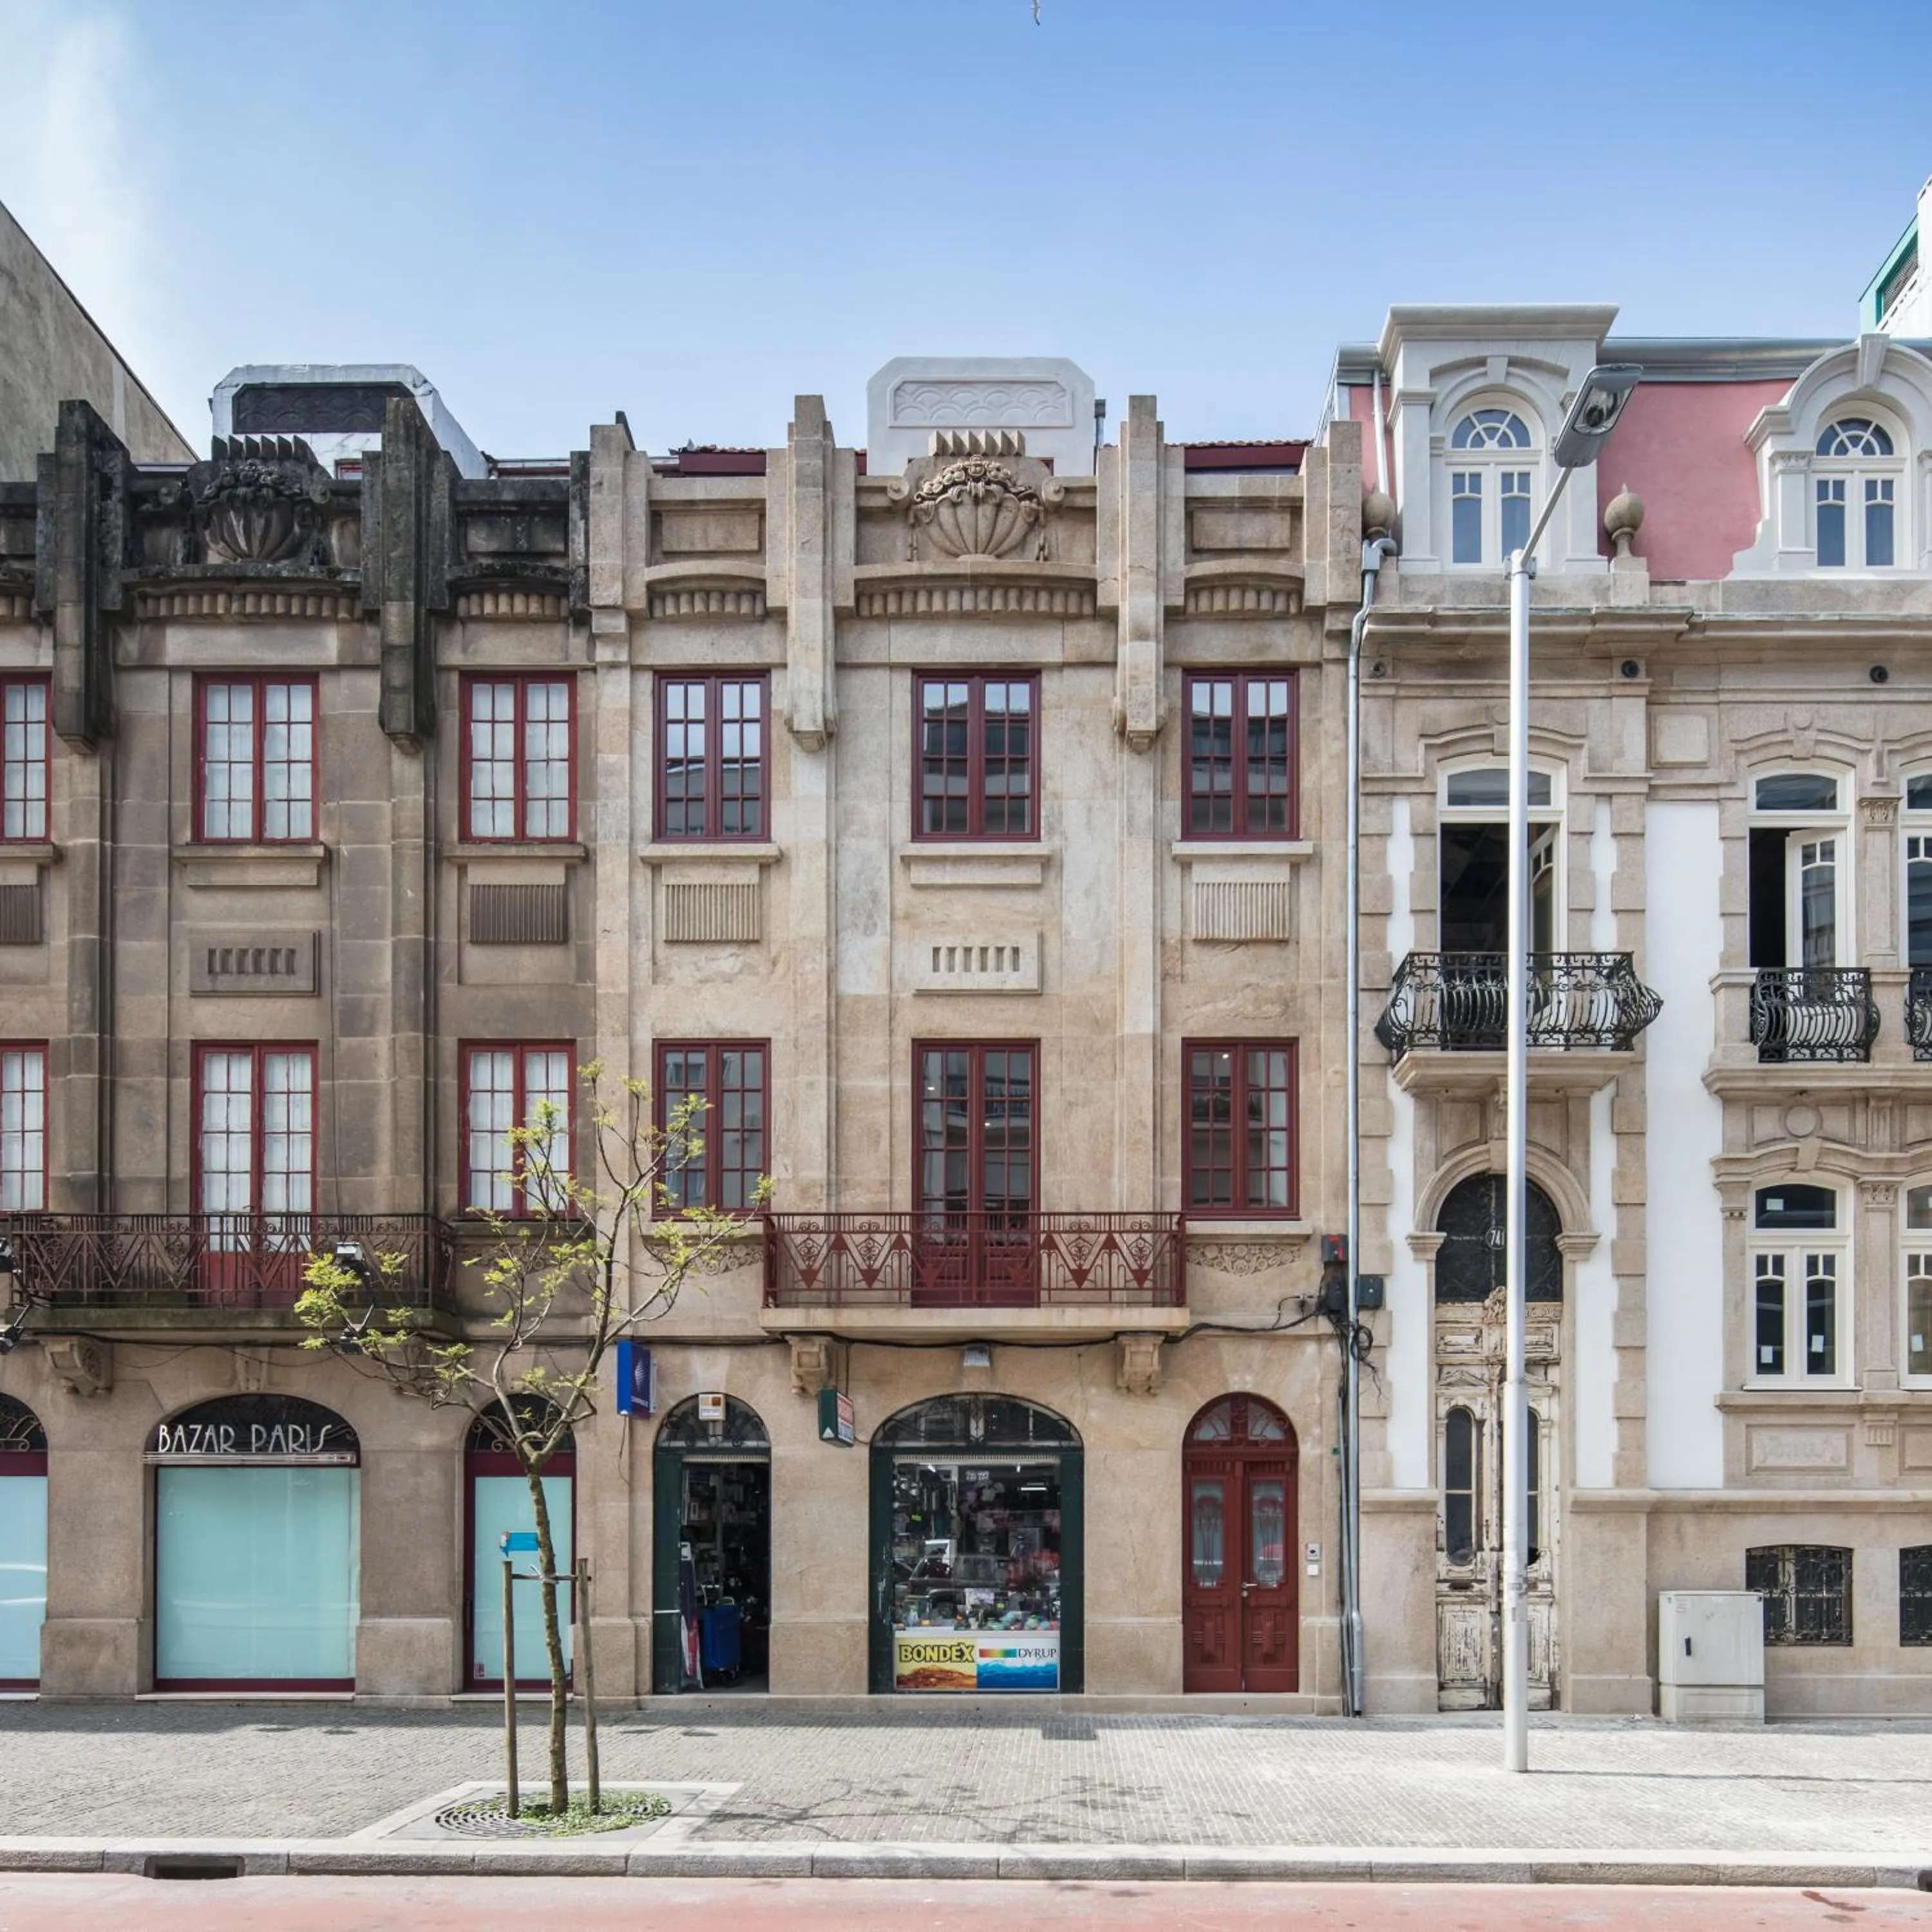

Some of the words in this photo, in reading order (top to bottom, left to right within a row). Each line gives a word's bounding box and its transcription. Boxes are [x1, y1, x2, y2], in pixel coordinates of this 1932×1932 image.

[158, 1424, 236, 1454] BAZAR
[251, 1424, 332, 1454] PARIS
[898, 1643, 975, 1663] BONDEX
[1018, 1647, 1057, 1660] DYRUP
